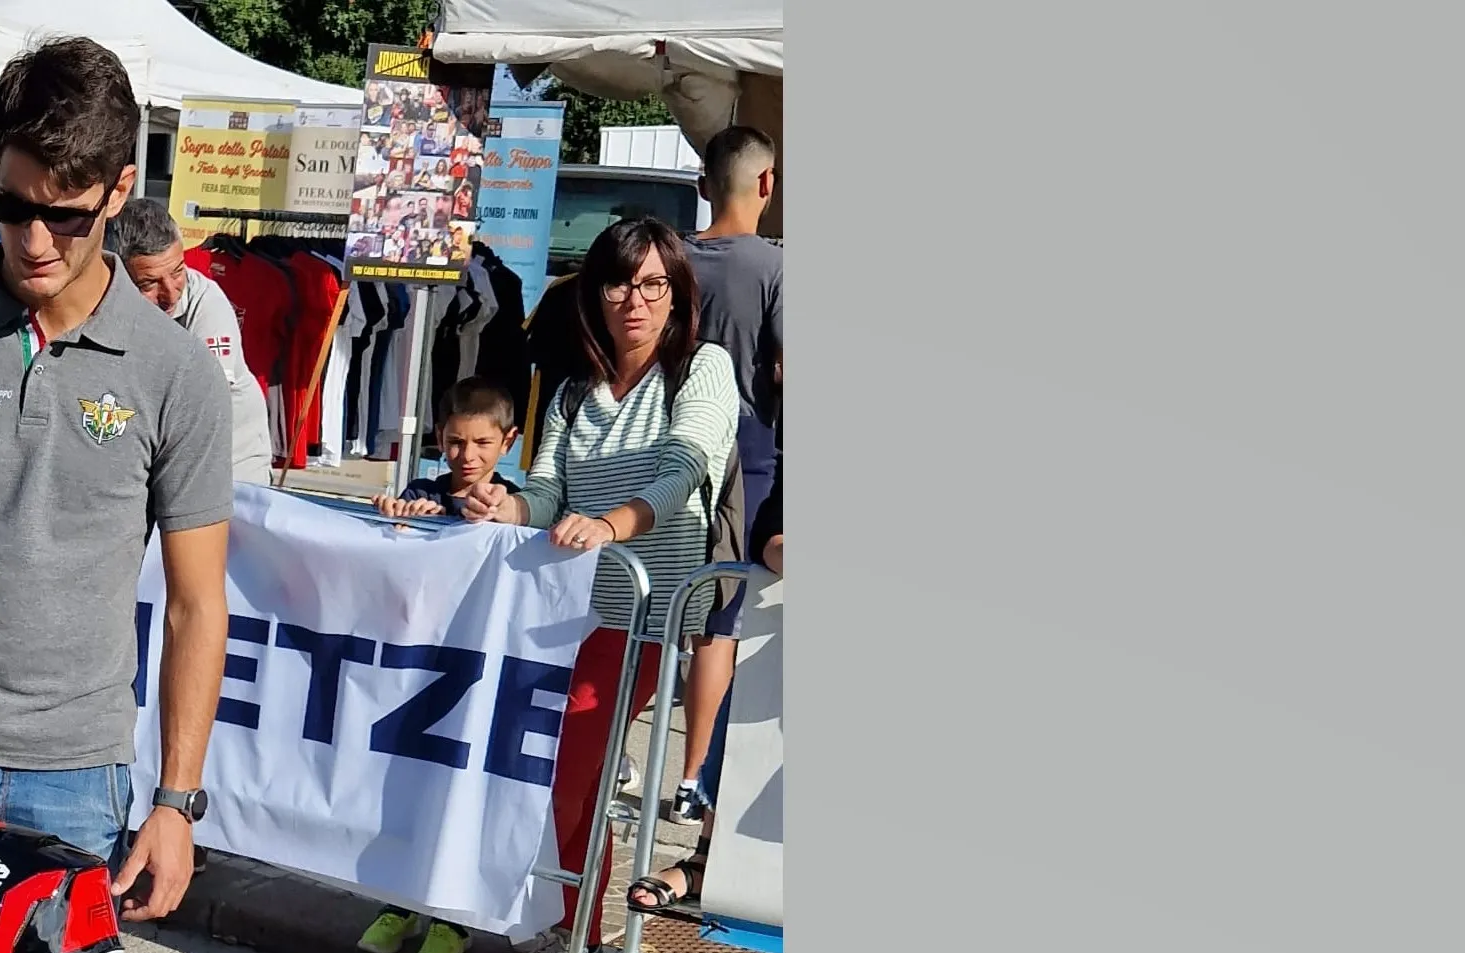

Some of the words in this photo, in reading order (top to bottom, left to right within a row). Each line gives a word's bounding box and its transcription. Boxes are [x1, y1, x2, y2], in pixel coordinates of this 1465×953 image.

[180, 136, 214, 158] Sagra
[218, 141, 246, 158] della
[330, 141, 358, 151] DOLC
[295, 153, 329, 174] San
[336, 155, 356, 174] M
[201, 182, 218, 194] FIERA
[219, 184, 231, 195] DEL
[298, 186, 333, 200] FIERA
[513, 208, 538, 220] RIMINI
[137, 602, 573, 788] ETZE
